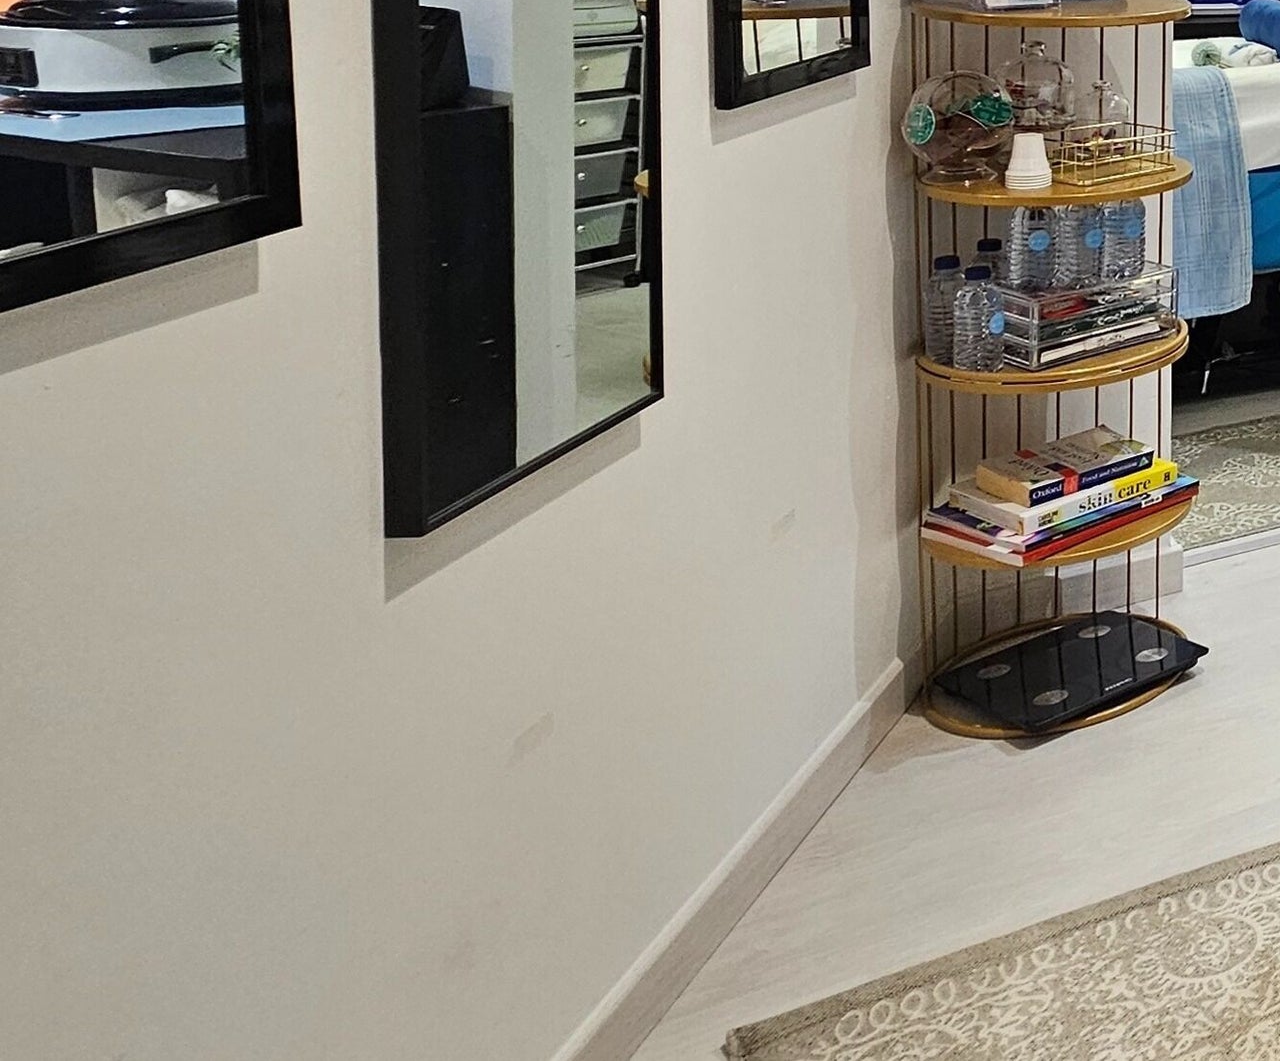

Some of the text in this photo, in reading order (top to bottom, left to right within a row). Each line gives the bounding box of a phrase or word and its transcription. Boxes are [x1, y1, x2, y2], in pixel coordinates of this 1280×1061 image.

[1080, 473, 1098, 484] Food
[1099, 468, 1110, 479] and
[1032, 483, 1063, 500] Oxford
[1078, 479, 1151, 514] skin care
